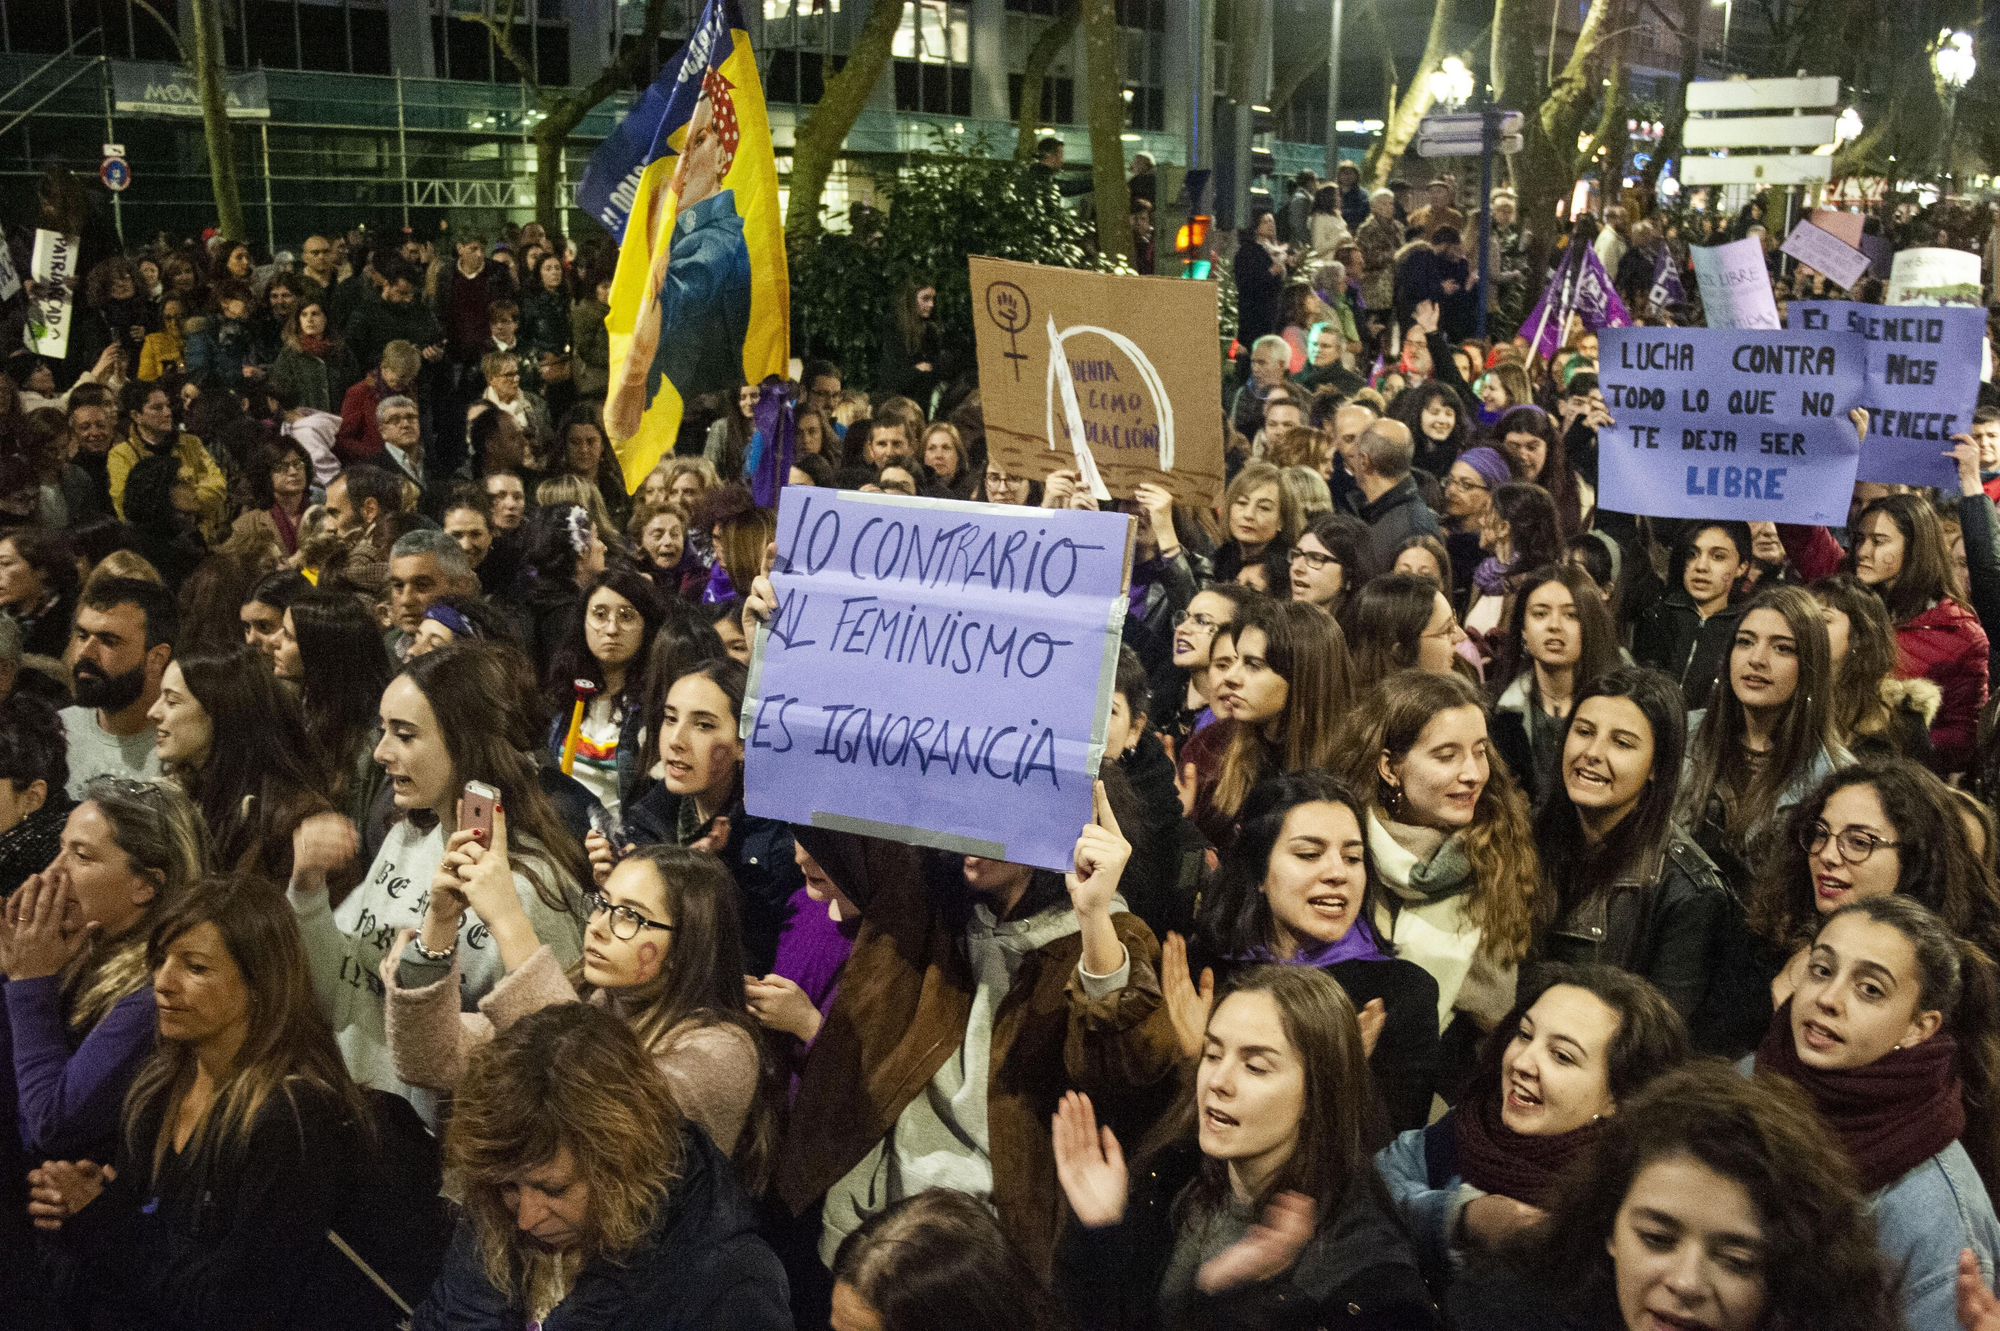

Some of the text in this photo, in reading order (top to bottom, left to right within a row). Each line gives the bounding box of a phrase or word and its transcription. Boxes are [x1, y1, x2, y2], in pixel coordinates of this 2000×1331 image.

[1621, 342, 1836, 376] LUCHA CONTRA
[1607, 384, 1834, 417] TODO LO QUE NO
[1629, 425, 1806, 455] TE DEJA SER
[1686, 465, 1788, 500] LIBRE
[782, 496, 1105, 598] LO CONTRARIO
[767, 587, 1073, 678] AL FEMINISMO
[751, 693, 1061, 790] ES IGNORANCIA
